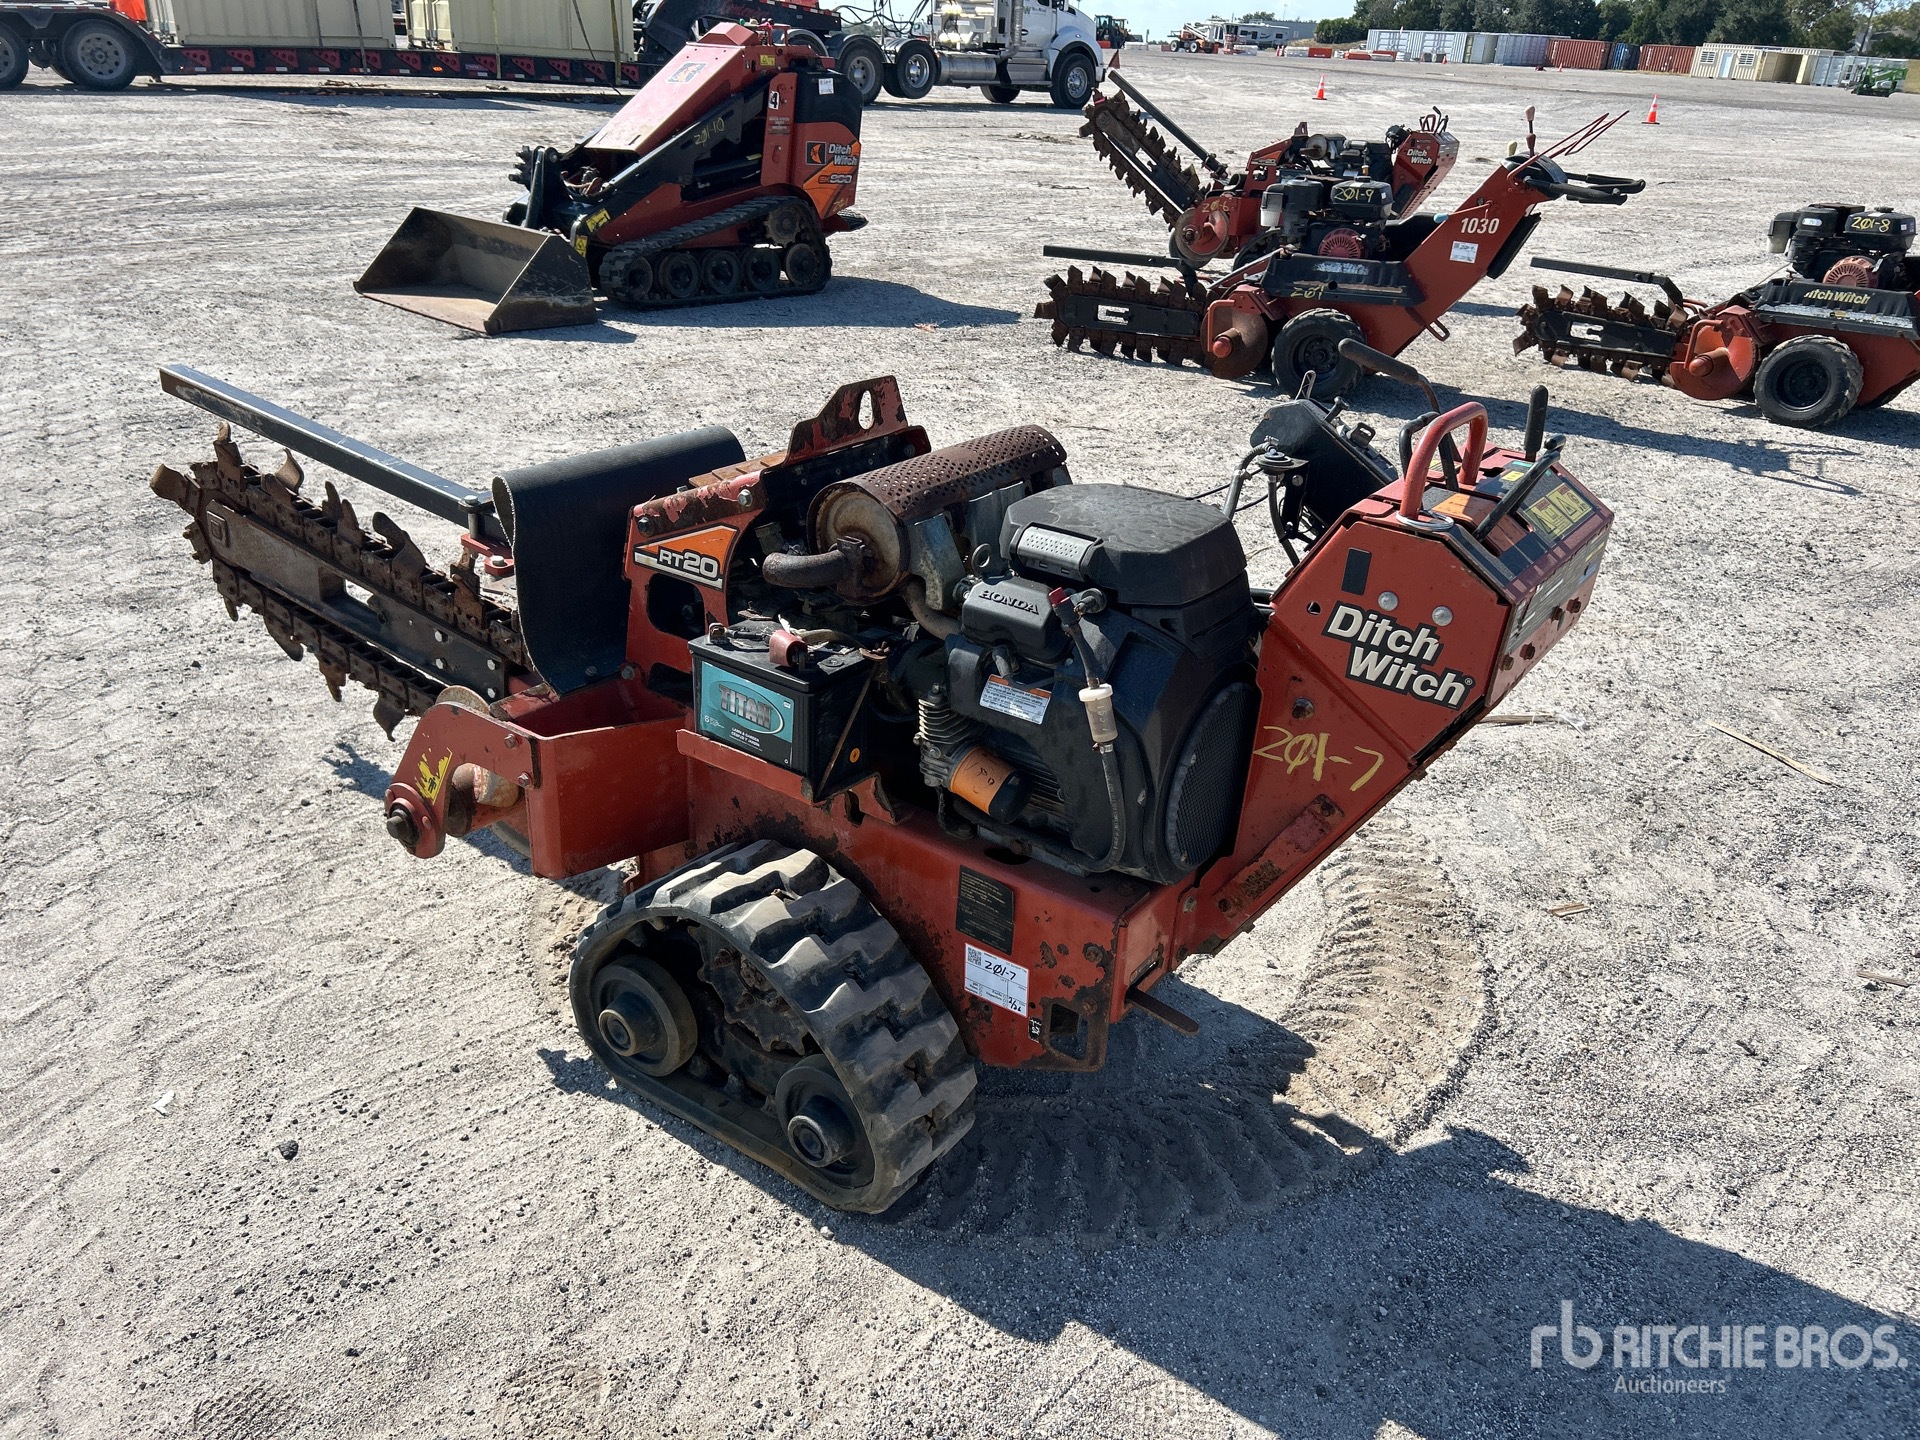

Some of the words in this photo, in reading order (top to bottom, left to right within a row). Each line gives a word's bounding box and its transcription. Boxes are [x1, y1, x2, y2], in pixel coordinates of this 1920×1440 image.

[828, 143, 852, 155] Ditch
[1406, 148, 1428, 157] Ditch
[834, 155, 858, 166] Witch
[1410, 156, 1433, 165] Witch
[1460, 217, 1500, 235] 1030
[1851, 216, 1891, 233] 201-8
[659, 548, 719, 579] RT20
[979, 589, 1040, 615] HONDA
[1326, 605, 1440, 662] Ditch
[718, 683, 773, 731] TITAN
